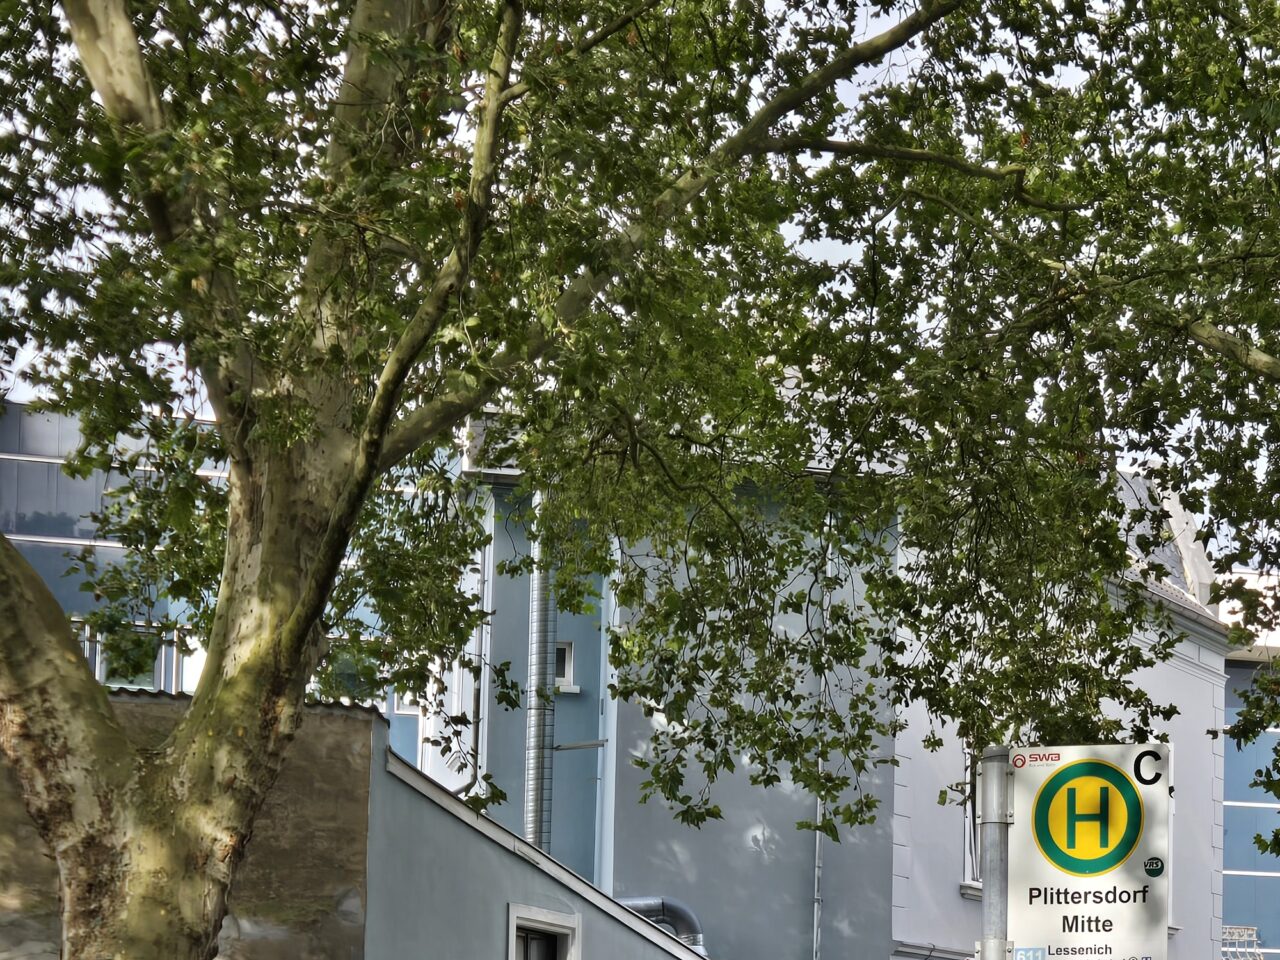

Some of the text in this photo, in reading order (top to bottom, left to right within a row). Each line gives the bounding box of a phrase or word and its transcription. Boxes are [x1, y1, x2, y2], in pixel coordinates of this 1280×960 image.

[1029, 753, 1061, 762] SWB
[1133, 750, 1163, 785] C
[1066, 786, 1110, 850] H
[1144, 860, 1160, 868] VRS
[1028, 885, 1150, 905] Plittersdorf
[1062, 915, 1114, 933] Mitte
[1047, 944, 1113, 956] Lessenich
